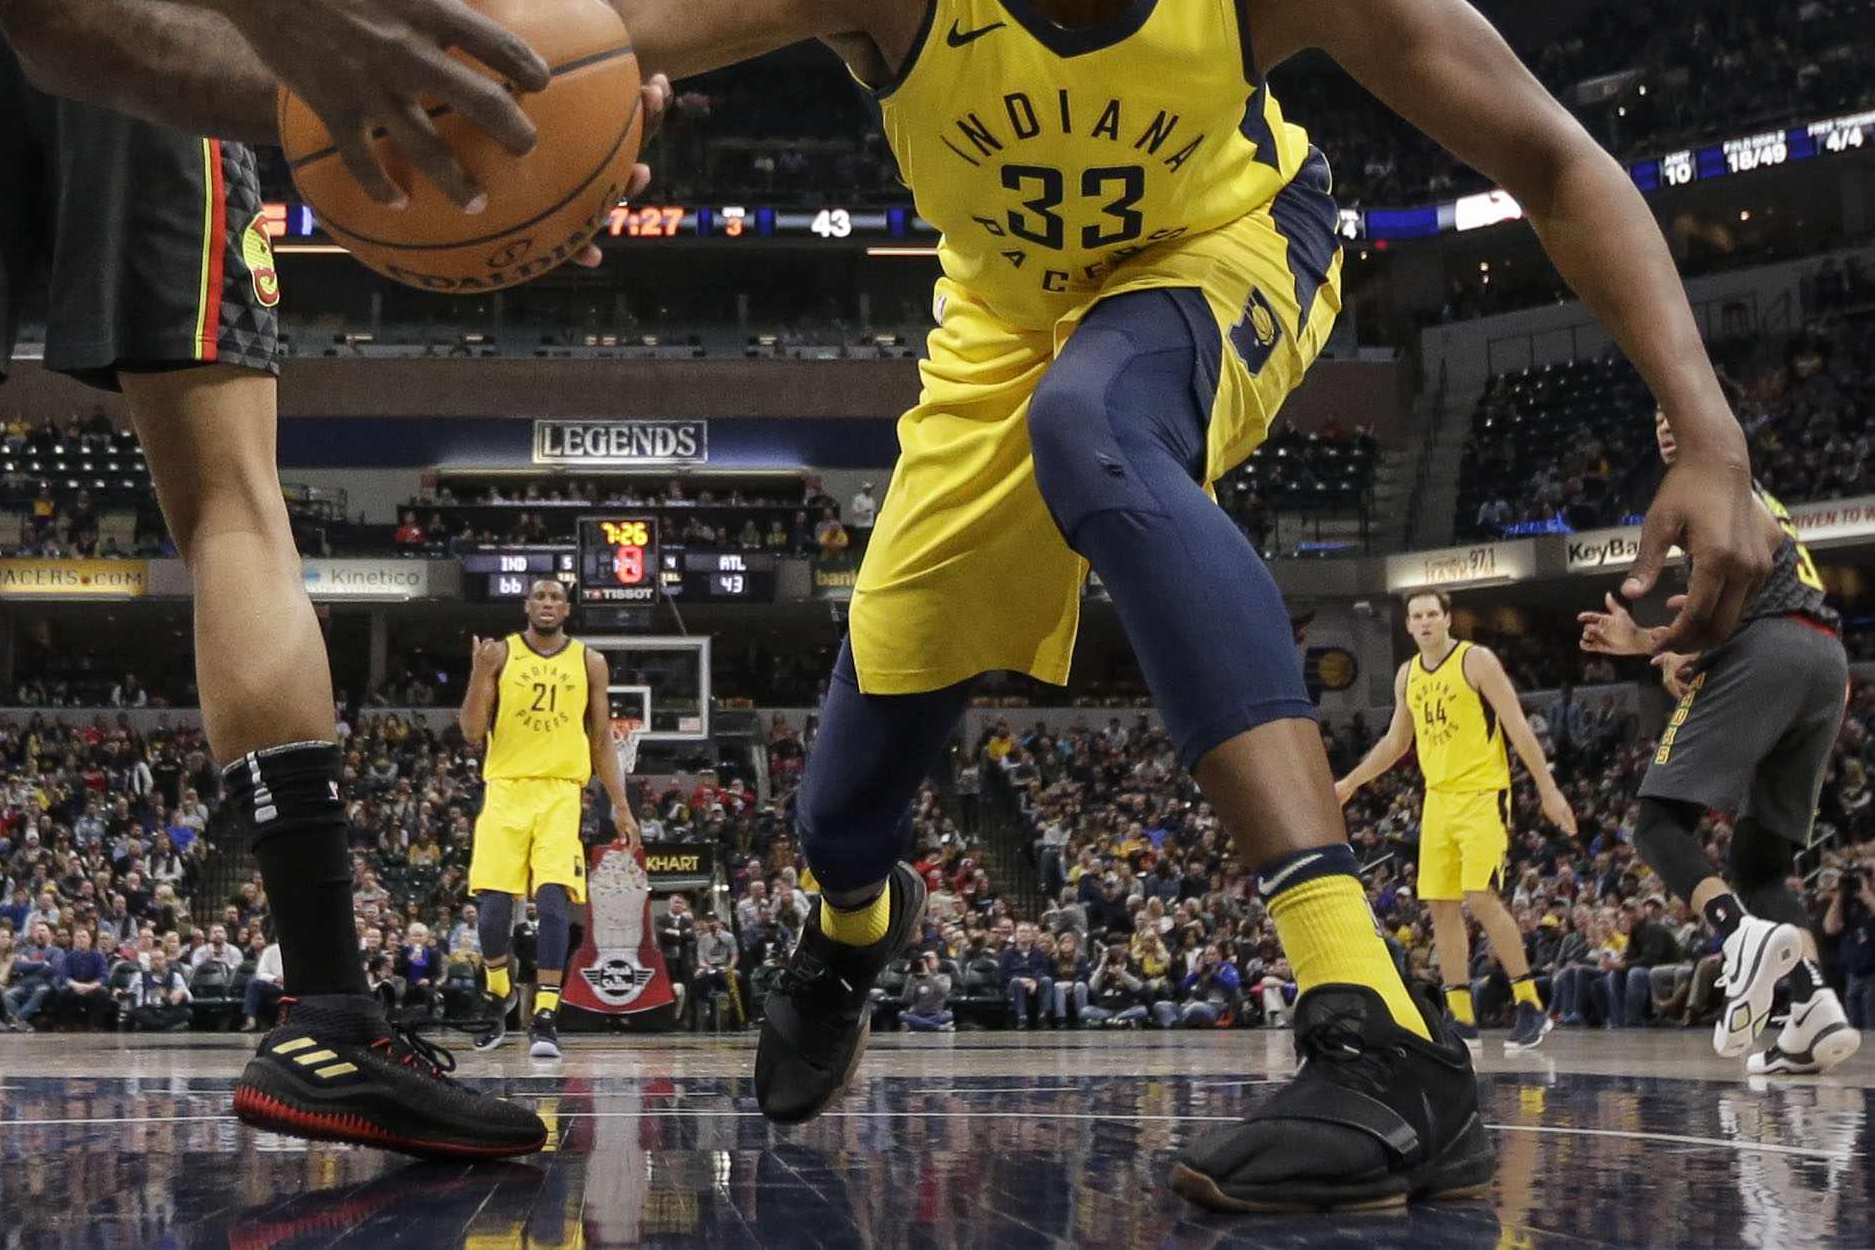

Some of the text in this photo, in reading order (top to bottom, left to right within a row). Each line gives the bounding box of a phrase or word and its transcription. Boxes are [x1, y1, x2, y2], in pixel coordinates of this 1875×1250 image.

[940, 89, 1205, 174] INDIANA
[1665, 163, 1693, 186] 10
[1000, 163, 1146, 251] 33
[609, 206, 685, 237] 7:27
[726, 217, 743, 237] 3
[811, 208, 853, 238] 43
[543, 426, 697, 457] LEGENDS
[600, 521, 649, 546] 7:26
[563, 556, 573, 570] 5
[1568, 536, 1641, 564] KeyBa
[499, 556, 527, 572] IND
[617, 545, 645, 584] 8
[719, 555, 747, 572] ATL
[331, 568, 421, 586] Kinetico
[720, 574, 744, 594] 43
[602, 588, 654, 600] TISSOT
[531, 682, 558, 713] 21
[1424, 698, 1448, 728] 44
